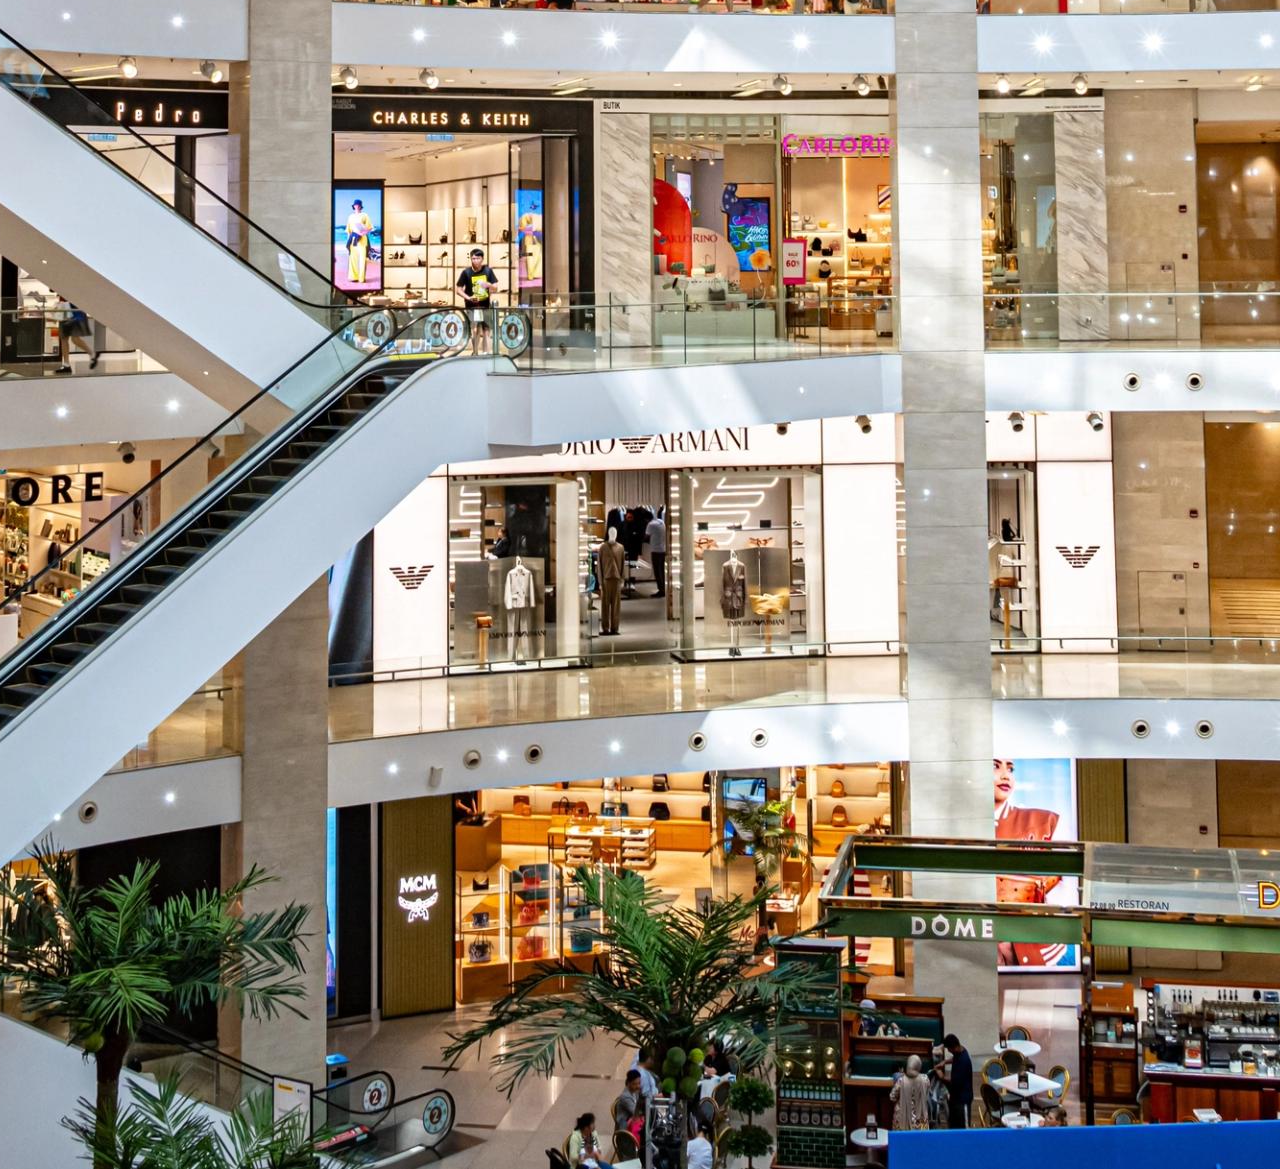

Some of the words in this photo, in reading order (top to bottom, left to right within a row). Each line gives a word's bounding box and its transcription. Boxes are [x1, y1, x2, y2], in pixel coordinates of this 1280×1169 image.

[116, 101, 201, 123] Pedro
[602, 100, 621, 111] BUTIK
[372, 111, 449, 125] CHARLES
[460, 113, 471, 125] &
[482, 113, 530, 126] KEITH
[782, 133, 858, 155] CARLO
[448, 323, 456, 336] 4
[650, 426, 750, 455] ARMANI
[399, 873, 438, 894] MCM
[1117, 898, 1170, 911] RESTORAN
[910, 913, 995, 939] DÔME
[372, 1091, 379, 1104] 2
[432, 1109, 440, 1121] 2
